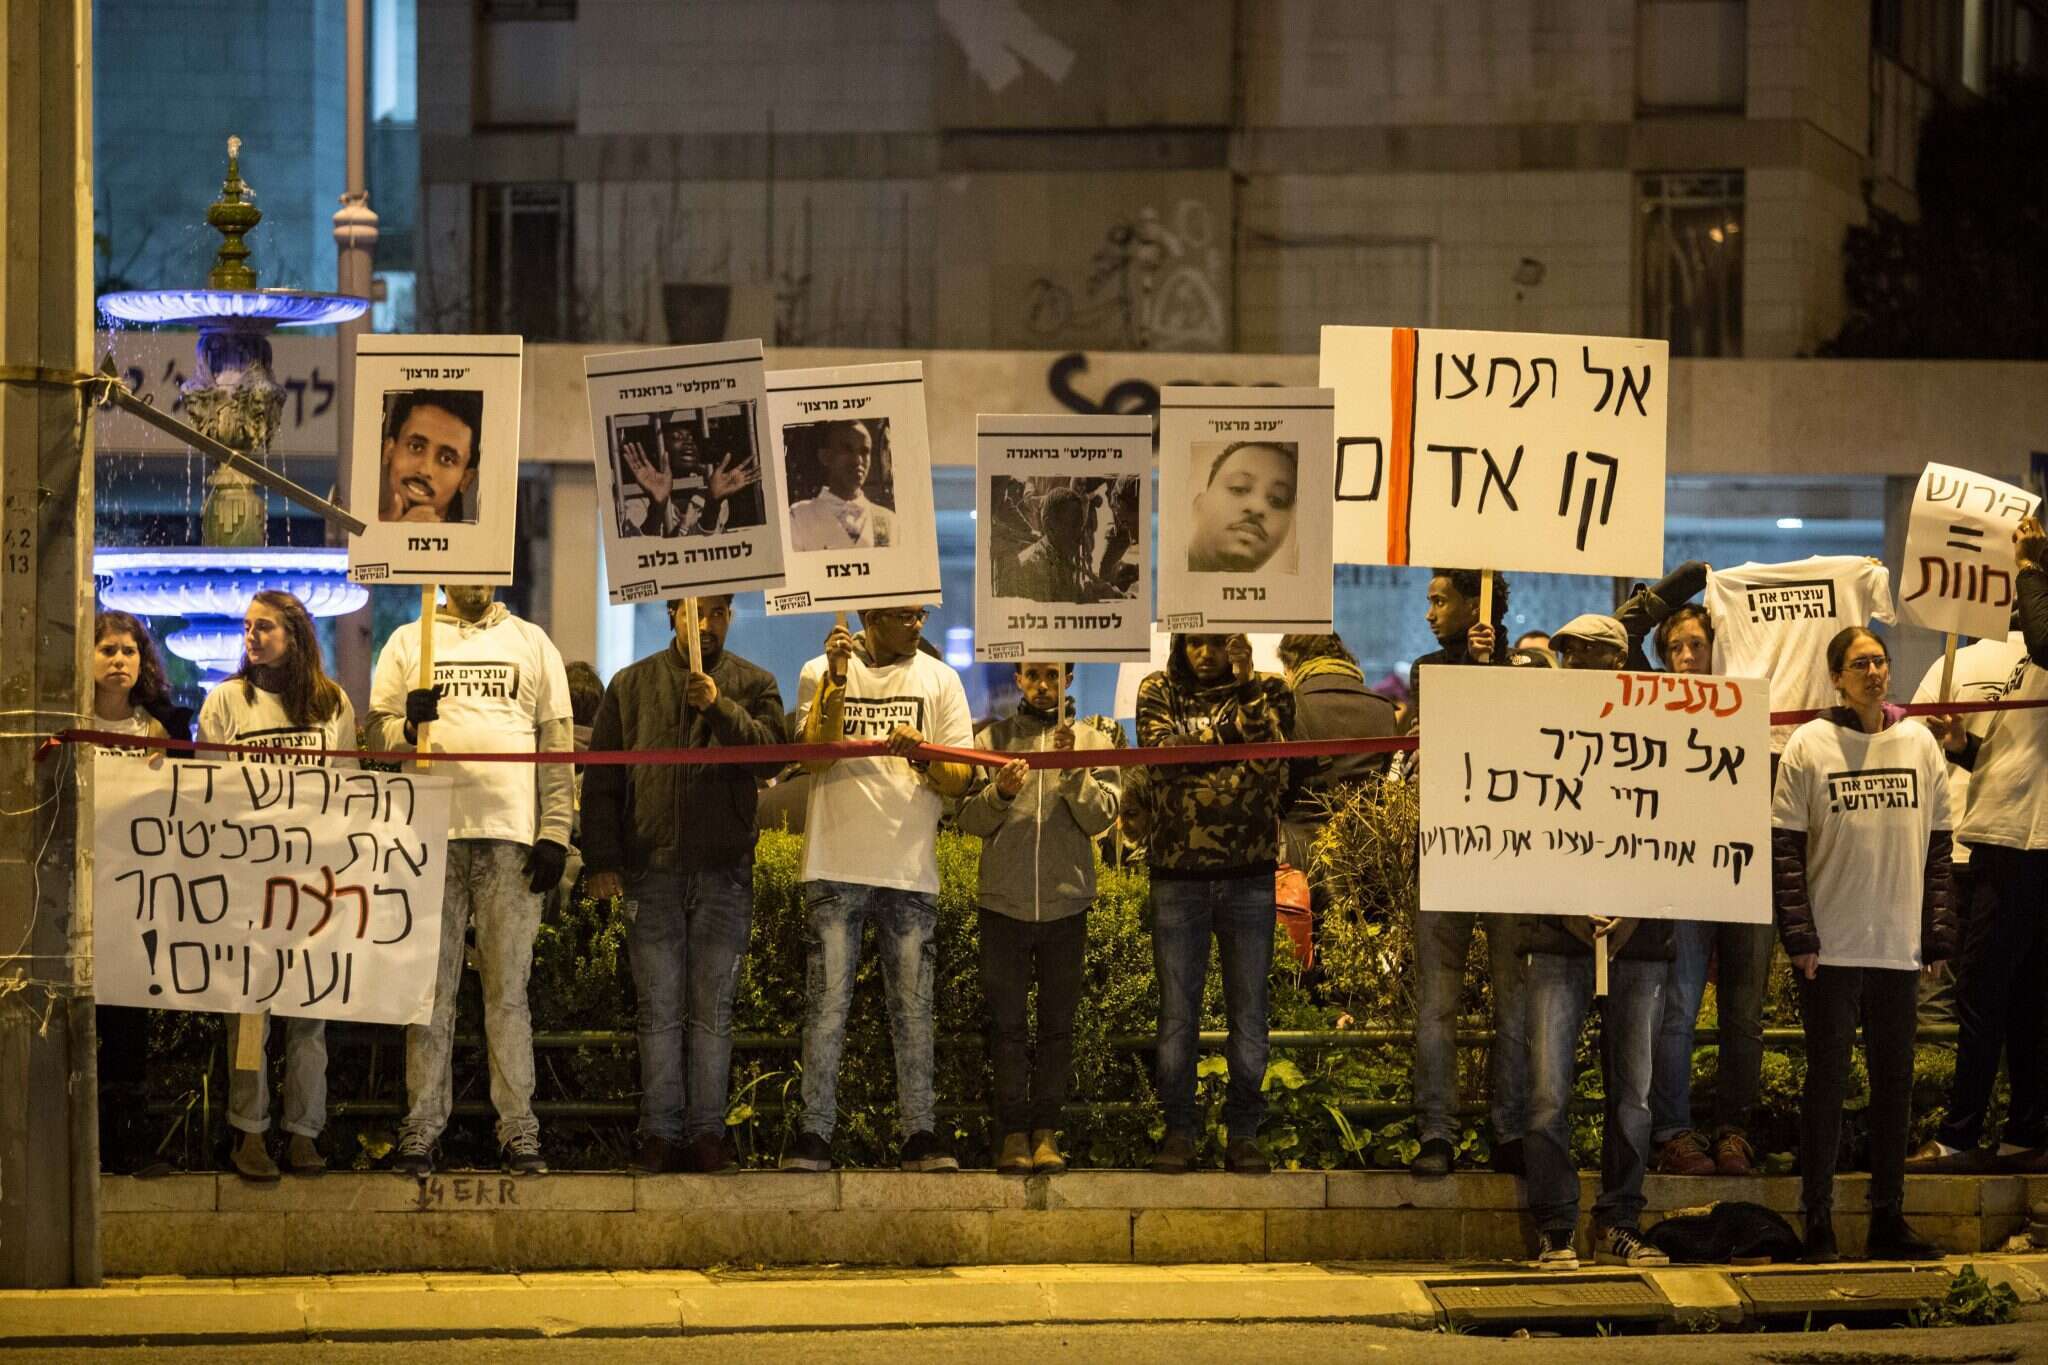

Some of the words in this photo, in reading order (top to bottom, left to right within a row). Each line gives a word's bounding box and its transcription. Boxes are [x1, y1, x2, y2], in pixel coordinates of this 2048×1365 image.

[1435, 352, 1558, 409] תחצו
[1582, 345, 1651, 417] אל
[618, 384, 673, 400] ברואנדה
[1006, 447, 1060, 459] ברואנדה
[1557, 450, 1619, 552] קו
[407, 537, 449, 551] נרצח
[684, 541, 753, 564] לסחורה
[637, 549, 679, 569] בלוב
[825, 562, 871, 578] נרצח
[1903, 556, 2012, 607] מוות
[1221, 586, 1267, 601] נרצח
[1758, 592, 1778, 604] את
[1780, 588, 1824, 602] עוצרים
[1007, 613, 1049, 630] בלוב
[1054, 612, 1123, 630] לסחורה
[433, 669, 455, 681] את
[459, 669, 508, 680] עוצרים
[866, 705, 913, 719] עוצרים
[272, 735, 316, 749] עוצרים
[1539, 727, 1668, 777] תפקיר
[1685, 727, 1746, 786] אל
[167, 763, 223, 818] דן
[1841, 780, 1862, 792] את
[1864, 776, 1908, 790] עוצרים
[241, 764, 415, 826] הגירוש
[1610, 785, 1659, 820] חיי
[1420, 824, 1492, 857] הגירוש
[1492, 828, 1532, 861] את
[334, 831, 428, 878] את
[1712, 841, 1755, 886] קח
[114, 869, 230, 925] סחר
